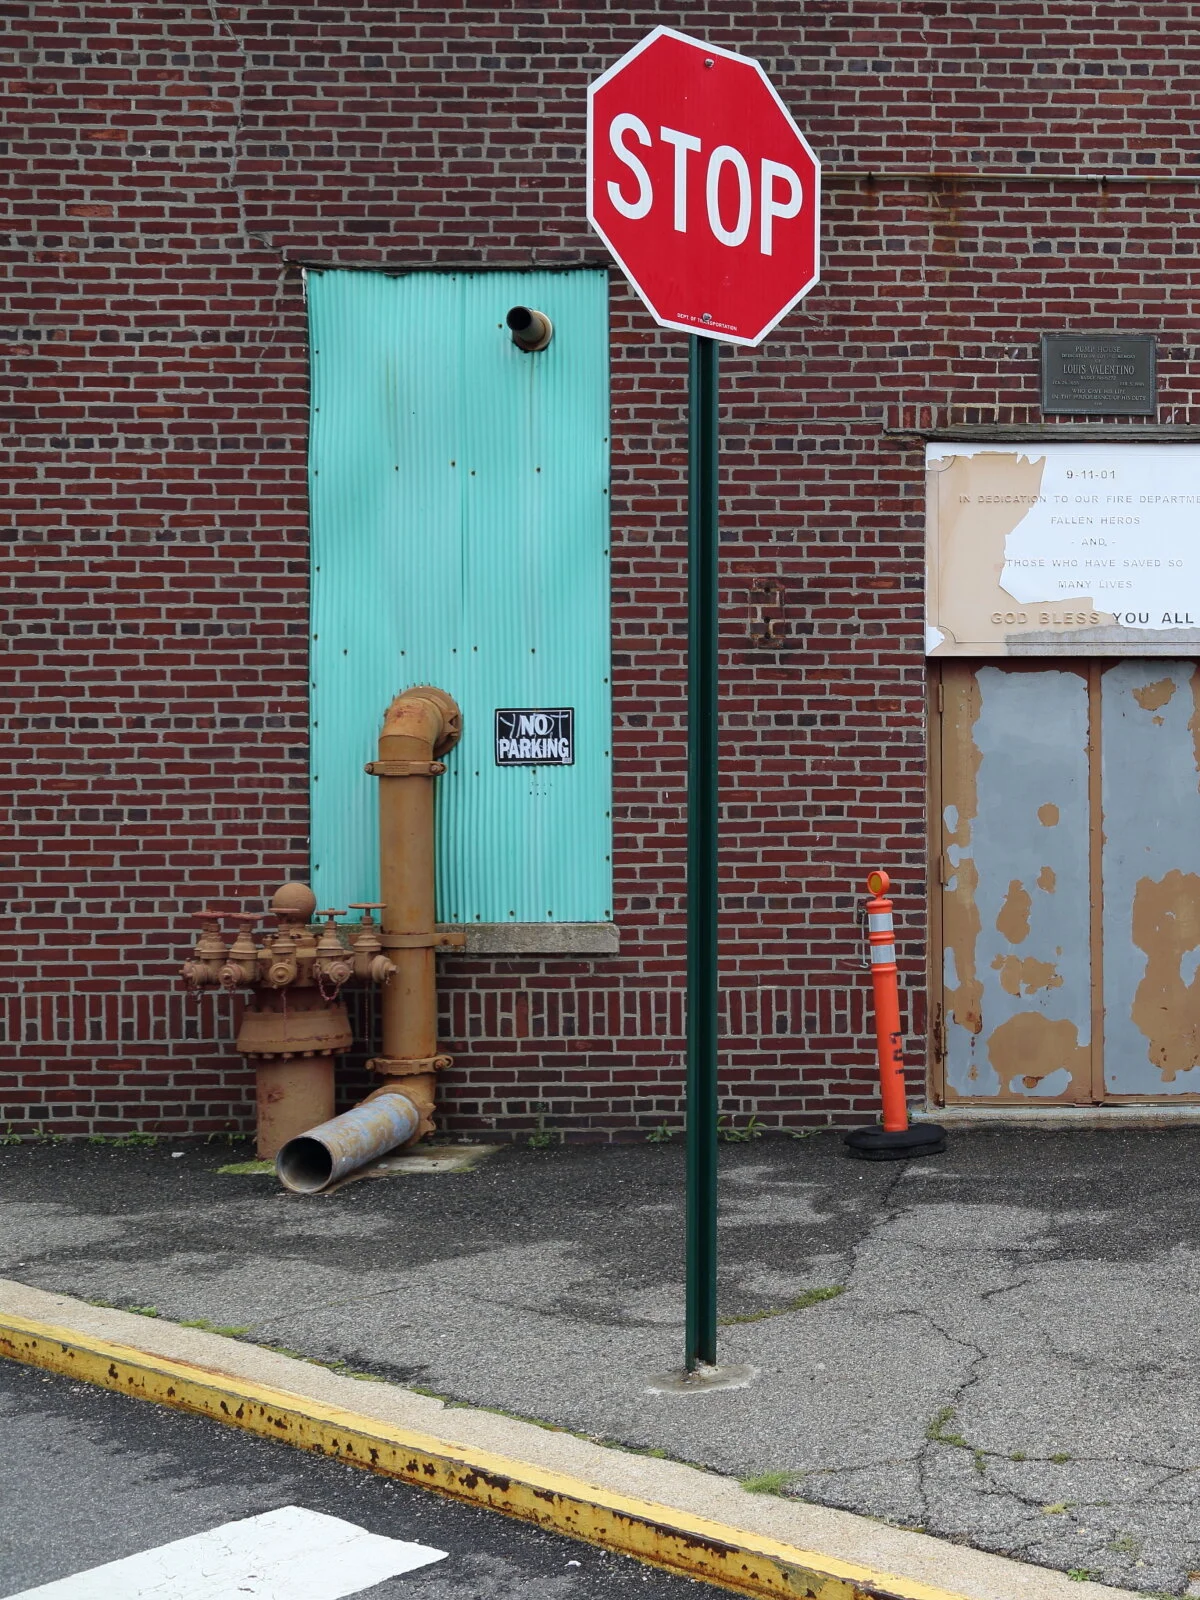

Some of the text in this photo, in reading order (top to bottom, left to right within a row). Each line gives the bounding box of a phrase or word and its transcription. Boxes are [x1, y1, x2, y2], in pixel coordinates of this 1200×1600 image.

[607, 112, 803, 256] STOP
[1075, 345, 1121, 353] PUMP HOUSE
[1063, 364, 1135, 375] LOUIS VALENTINO
[1066, 469, 1117, 480] 9-11-01
[959, 495, 971, 503] IN
[977, 495, 1047, 504] DEDICATION
[1053, 495, 1069, 504] TO
[1074, 495, 1100, 504] OUR
[1106, 495, 1133, 504] FIRE
[1050, 516, 1141, 525] FALLEN HEROS
[1007, 559, 1184, 567] THOSE WHO HAVE SAVED SO
[1058, 580, 1133, 589] MANY LIVES
[990, 612, 1194, 625] GOD BLESS YOU ALL
[520, 713, 548, 736] NO
[499, 738, 569, 759] PARKING
